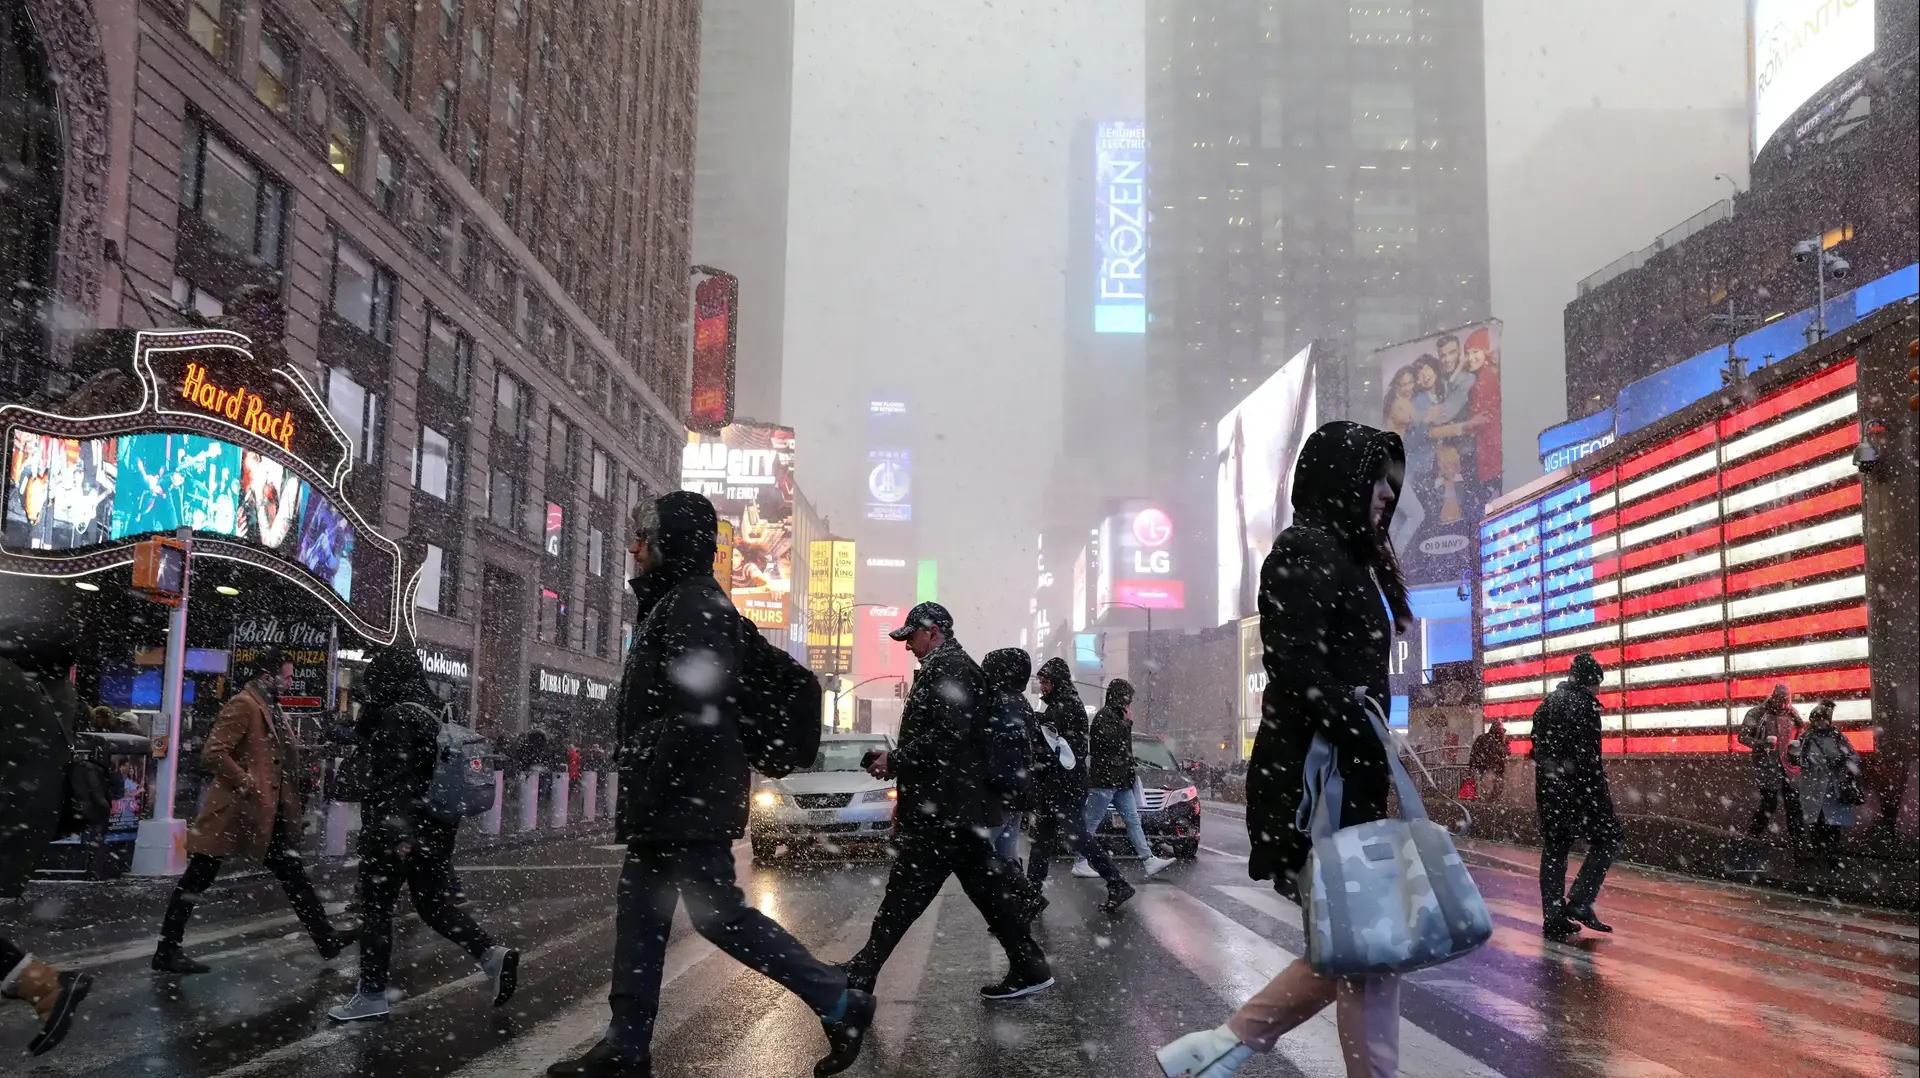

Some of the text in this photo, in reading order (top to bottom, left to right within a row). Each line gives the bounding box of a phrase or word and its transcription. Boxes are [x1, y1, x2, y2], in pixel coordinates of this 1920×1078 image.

[1101, 161, 1145, 299] FROZEN
[182, 362, 294, 452] Hard Rock
[728, 449, 776, 476] CITY
[1425, 538, 1463, 550] OLD NAVY
[835, 567, 853, 578] KING
[836, 557, 852, 567] LION
[1134, 551, 1170, 573] LG
[744, 607, 783, 623] THURS
[238, 620, 326, 644] Bella Vita
[296, 650, 325, 664] PIZZA
[540, 669, 561, 693] BUBBA
[562, 674, 580, 696] GUMP
[586, 678, 608, 700] SHRIMP
[1248, 672, 1266, 692] OLD
